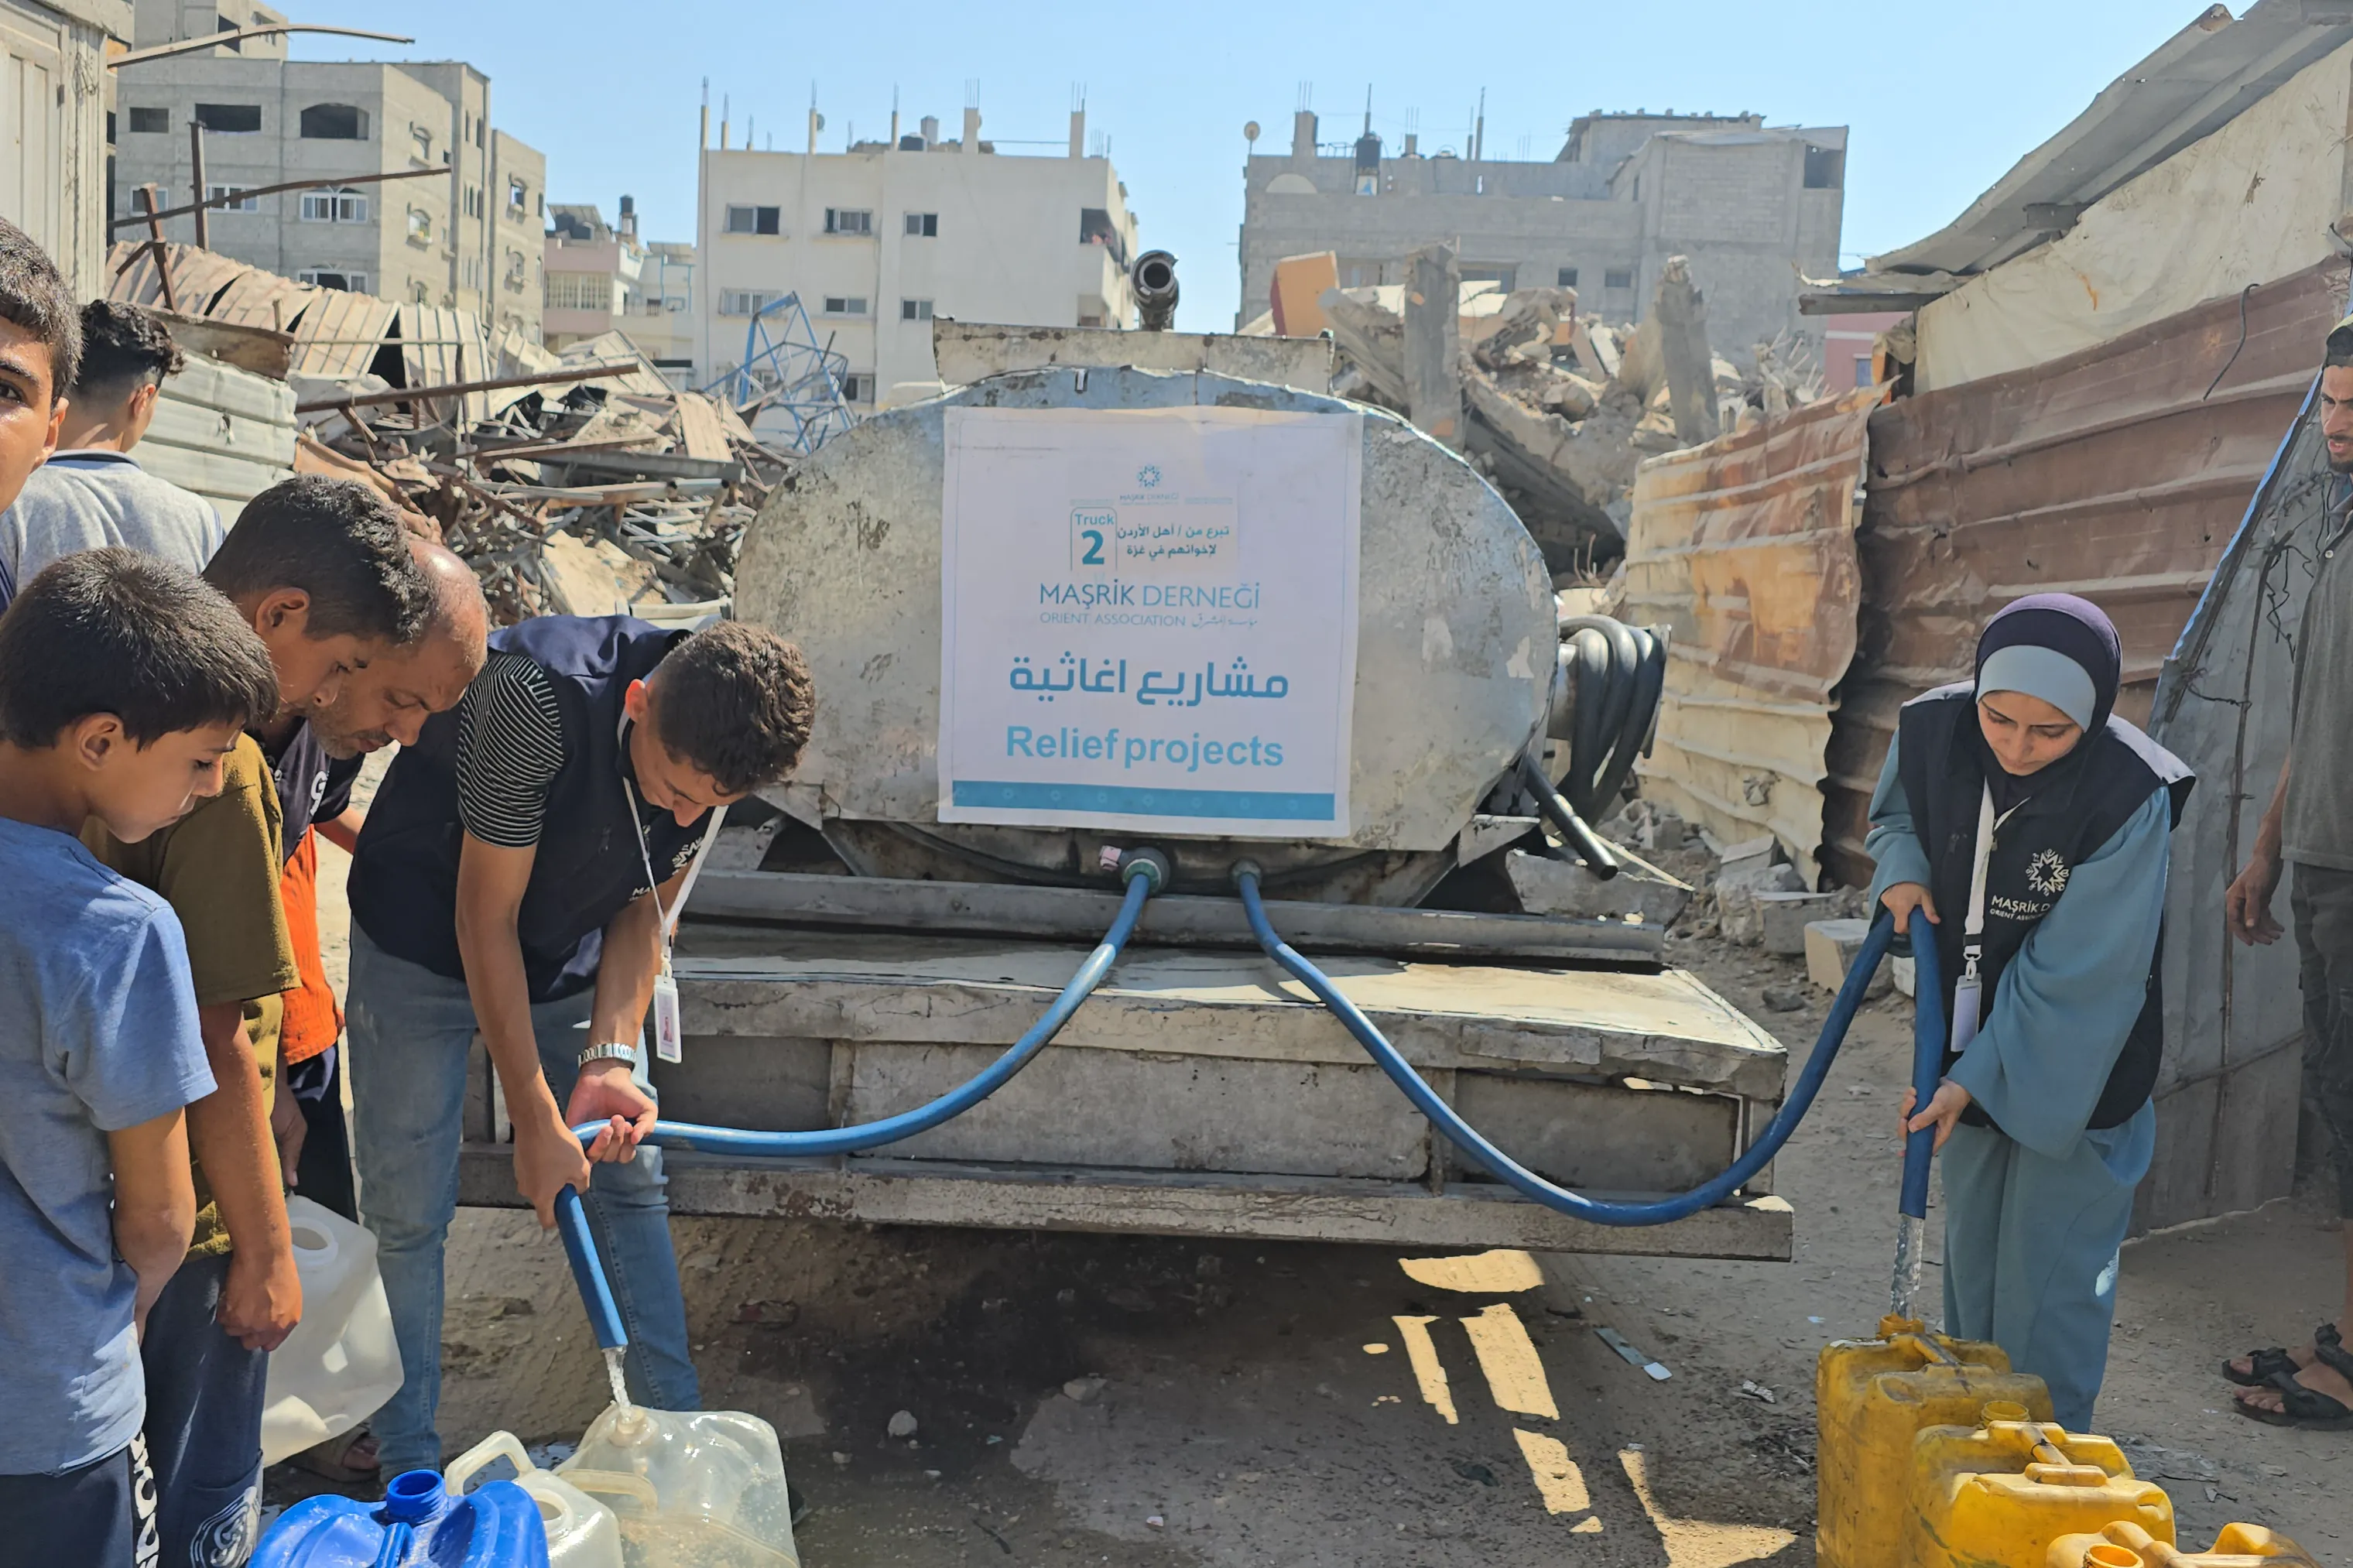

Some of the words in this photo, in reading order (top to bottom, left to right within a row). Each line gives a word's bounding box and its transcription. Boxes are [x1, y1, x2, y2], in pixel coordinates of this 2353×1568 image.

[1074, 513, 1115, 526] Truck
[1118, 523, 1150, 539] الأردن
[1153, 523, 1175, 539] أهل
[1185, 526, 1204, 539] من
[1205, 526, 1230, 540] تبرع
[1081, 529, 1105, 565] 2
[1126, 544, 1146, 558] غزة
[1149, 544, 1166, 562] في
[1039, 578, 1135, 610] MAŞRİK
[1142, 582, 1260, 609] DERNEĞİ
[1039, 611, 1091, 625] ORIENT
[1094, 613, 1187, 628] ASSOCIATION
[1009, 650, 1127, 703] اغاثية
[1135, 656, 1289, 707] مشاريع
[1006, 725, 1120, 761] Relief
[1124, 732, 1284, 773] projects
[1991, 895, 2040, 913] MAŞRİK
[1989, 908, 2016, 919] ORIENT
